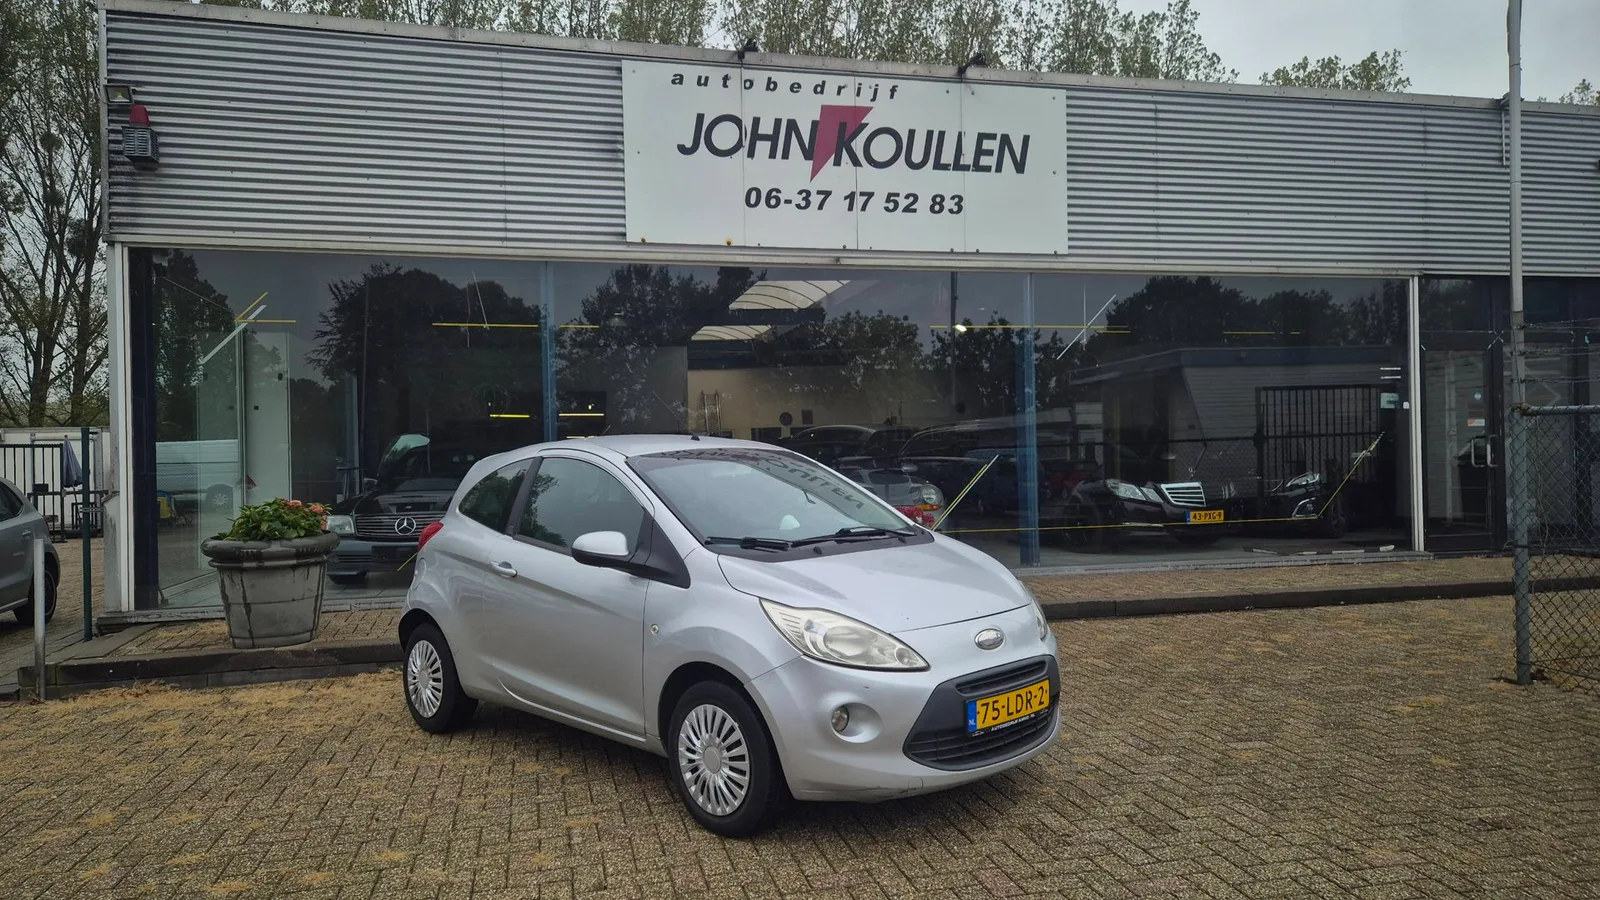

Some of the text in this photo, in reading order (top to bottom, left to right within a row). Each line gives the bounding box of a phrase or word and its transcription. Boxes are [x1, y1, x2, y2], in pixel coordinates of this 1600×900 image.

[670, 72, 899, 102] autobedrijf
[676, 112, 1031, 175] JOHN KOULLEN
[744, 186, 965, 216] 06-37 17 52 83
[1192, 511, 1223, 521] 43-PXG-9
[980, 685, 1045, 725] 75-LDR-2
